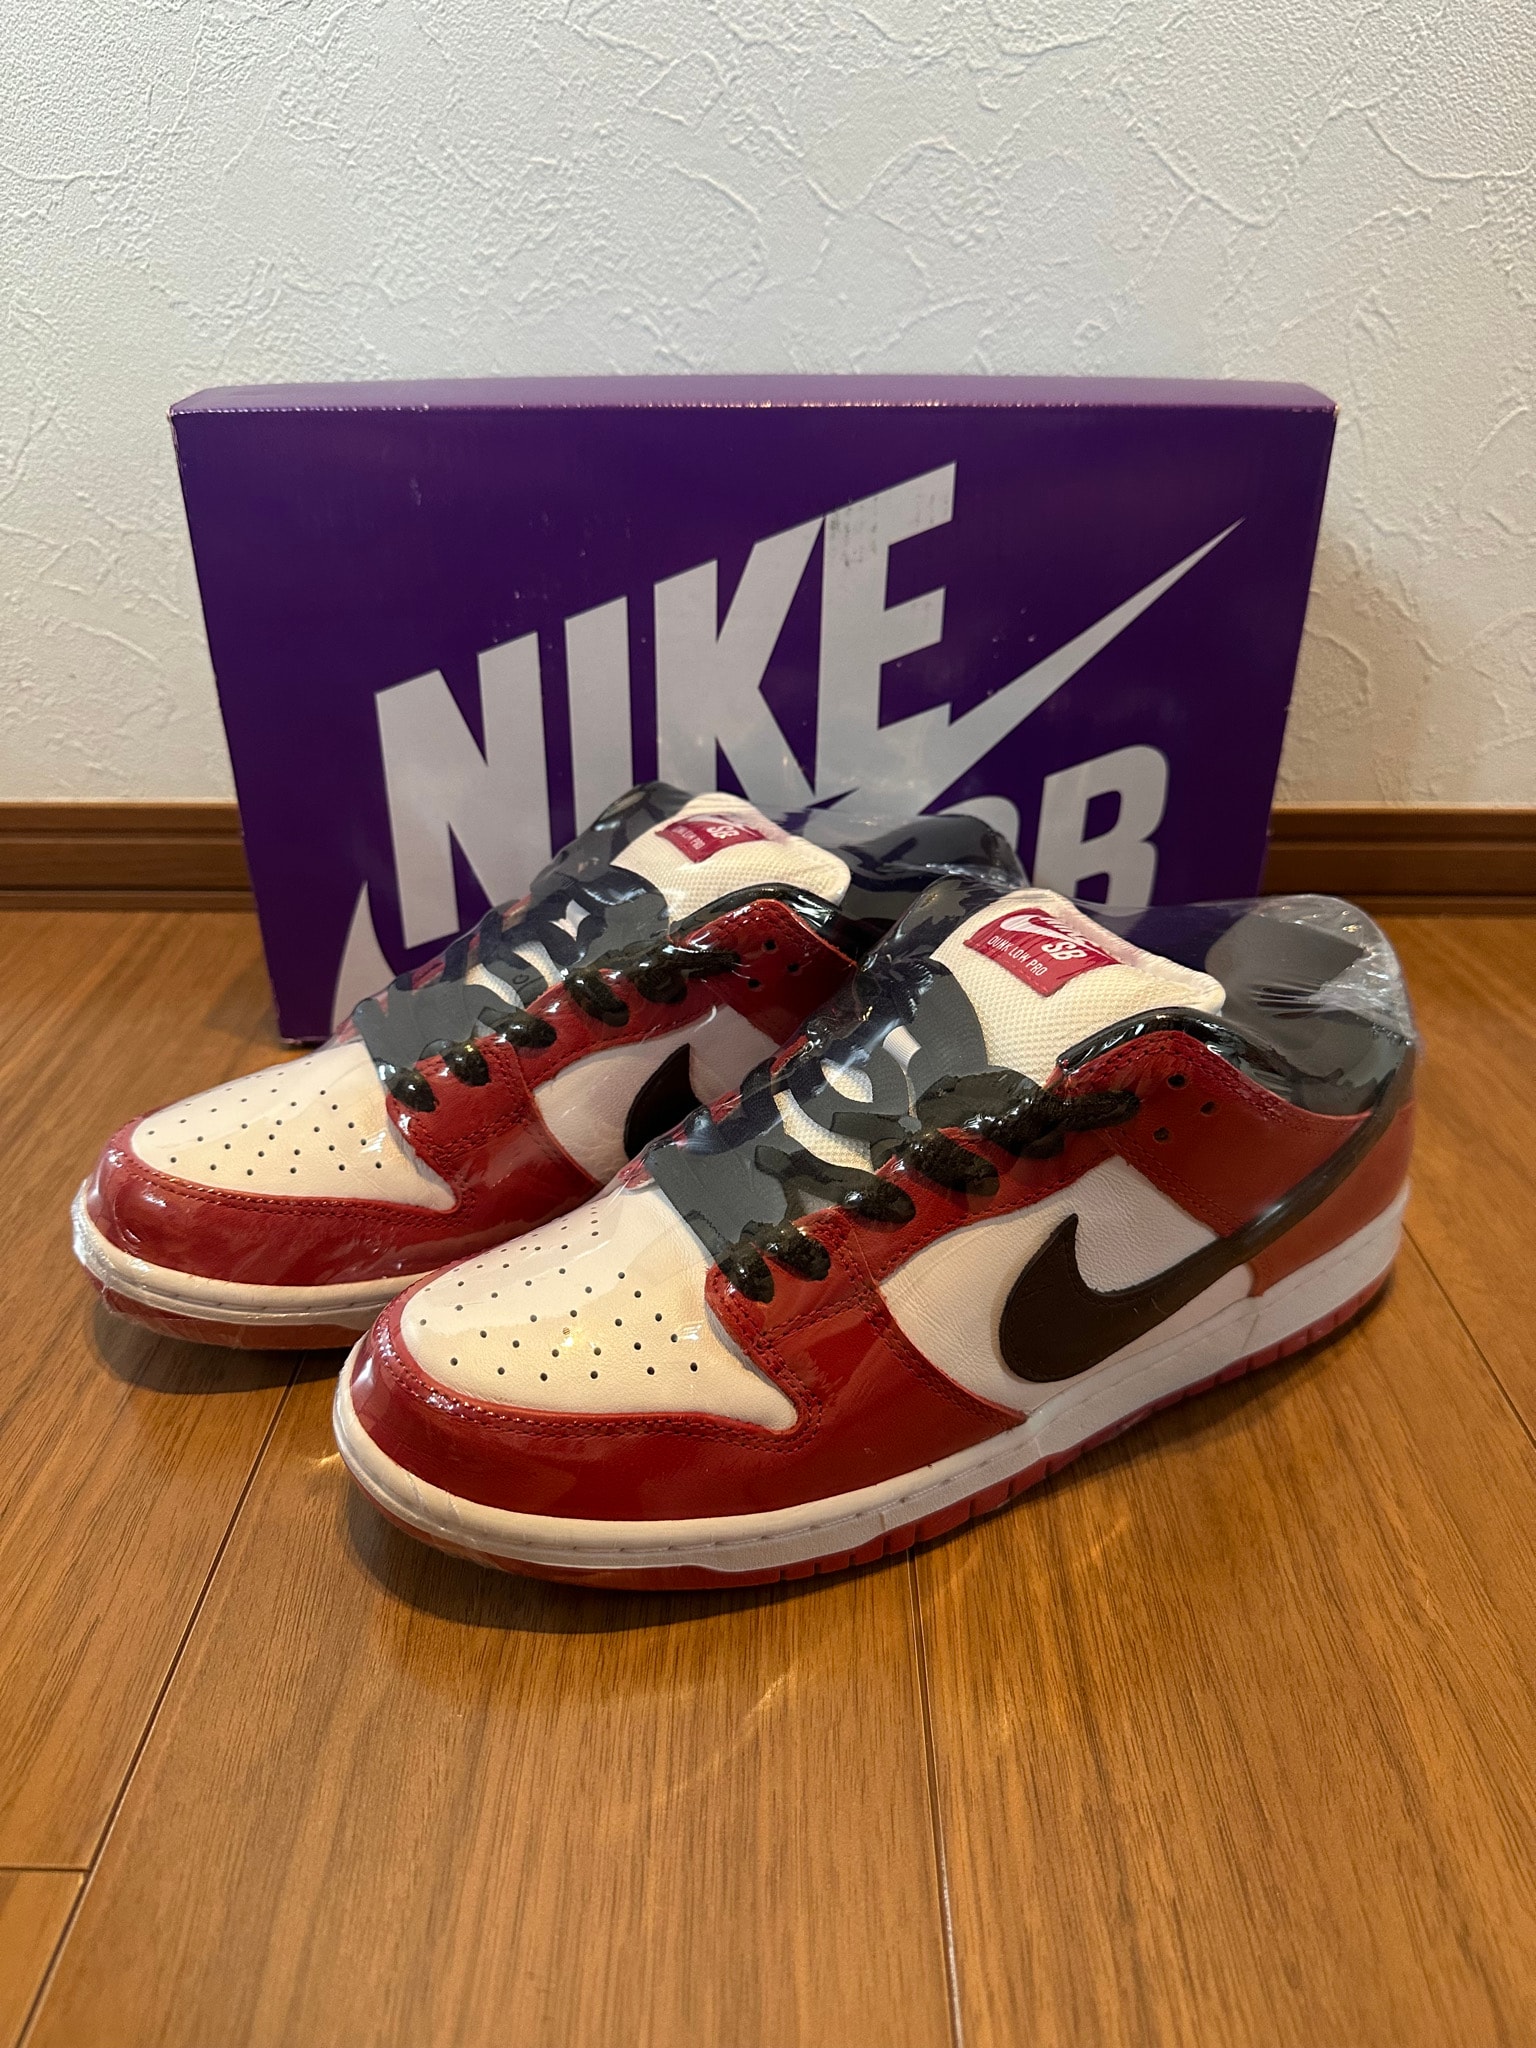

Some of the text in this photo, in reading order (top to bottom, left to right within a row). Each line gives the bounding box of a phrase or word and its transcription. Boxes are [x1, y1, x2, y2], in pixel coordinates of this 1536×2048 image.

[374, 460, 957, 950] NIKE
[706, 825, 740, 839] SB
[987, 935, 1048, 976] DUNK LOW PRO
[1041, 941, 1088, 960] SB
